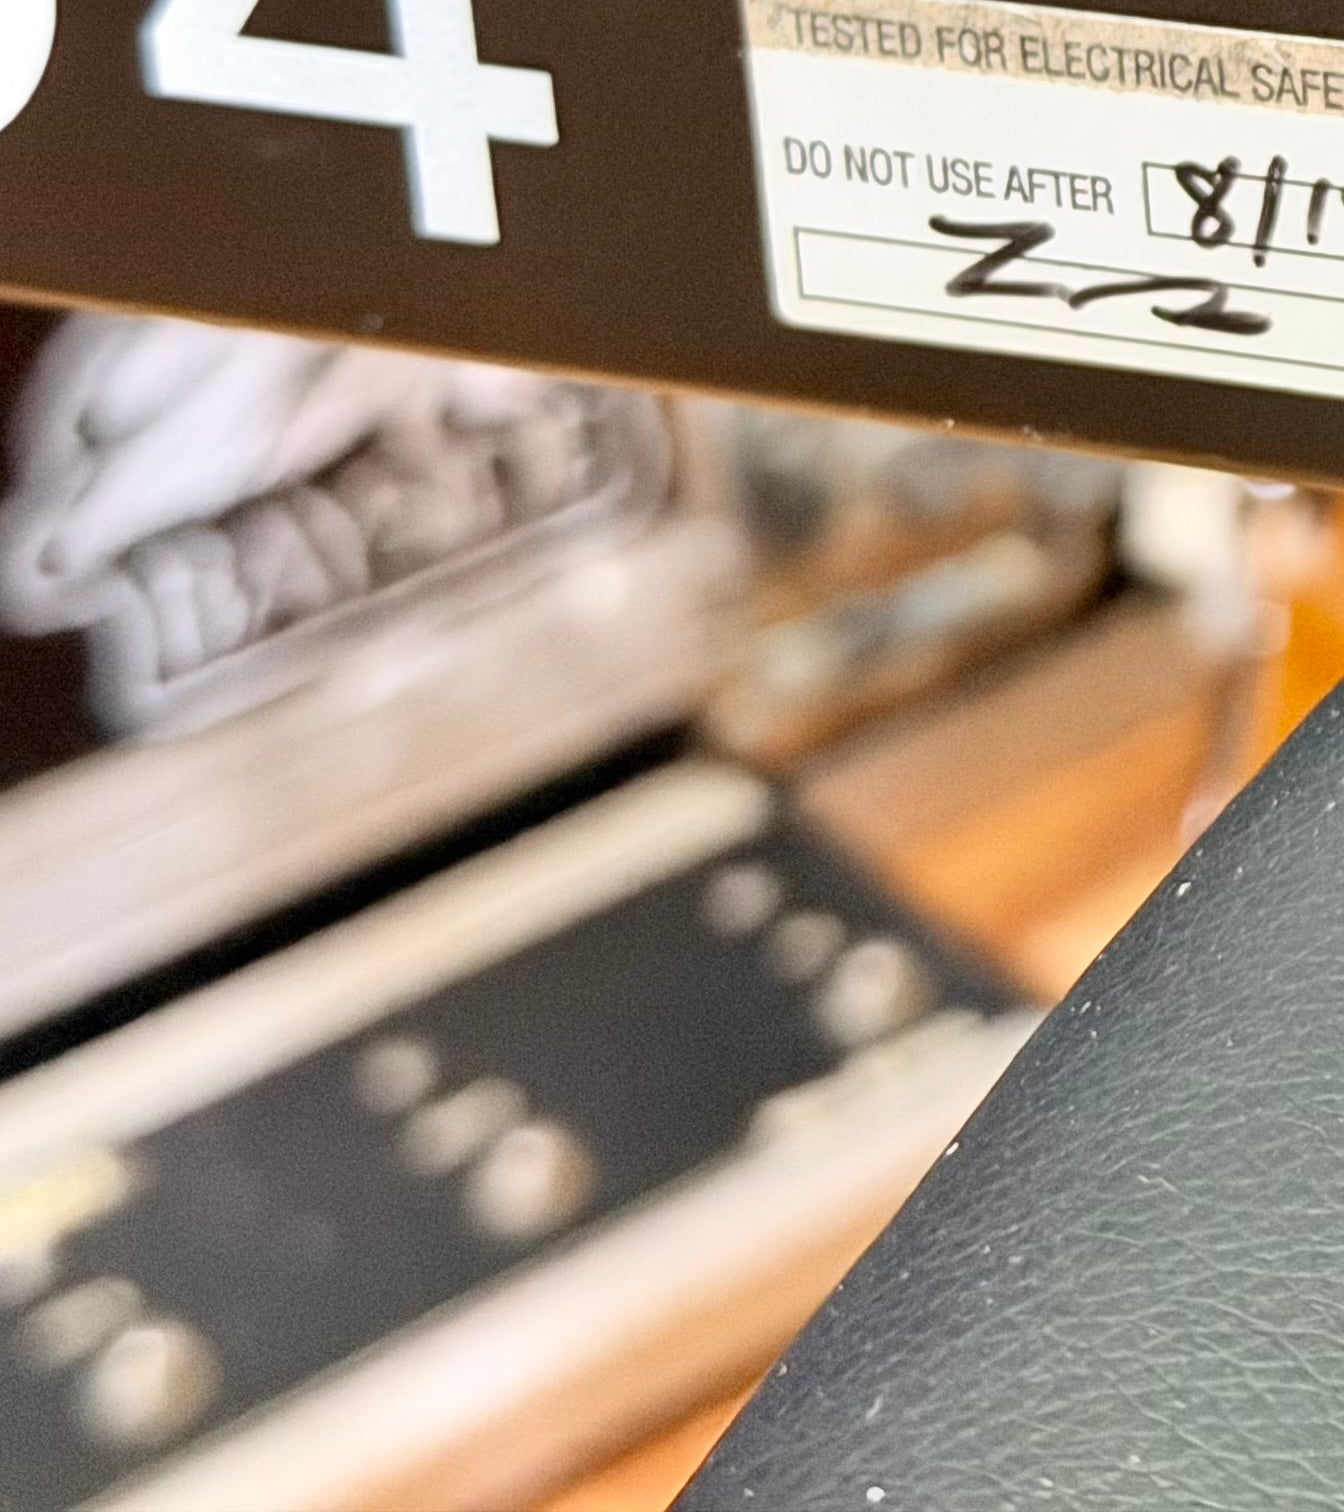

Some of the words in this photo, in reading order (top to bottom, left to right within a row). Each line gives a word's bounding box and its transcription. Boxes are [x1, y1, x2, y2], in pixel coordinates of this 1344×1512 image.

[790, 6, 924, 59] TESTED
[935, 27, 1009, 71] FOR
[1021, 35, 1242, 100] ELECTRICAL
[782, 136, 833, 180] DO
[843, 146, 916, 189] NOT
[925, 153, 996, 199] USE
[1003, 165, 1115, 215] AFTER
